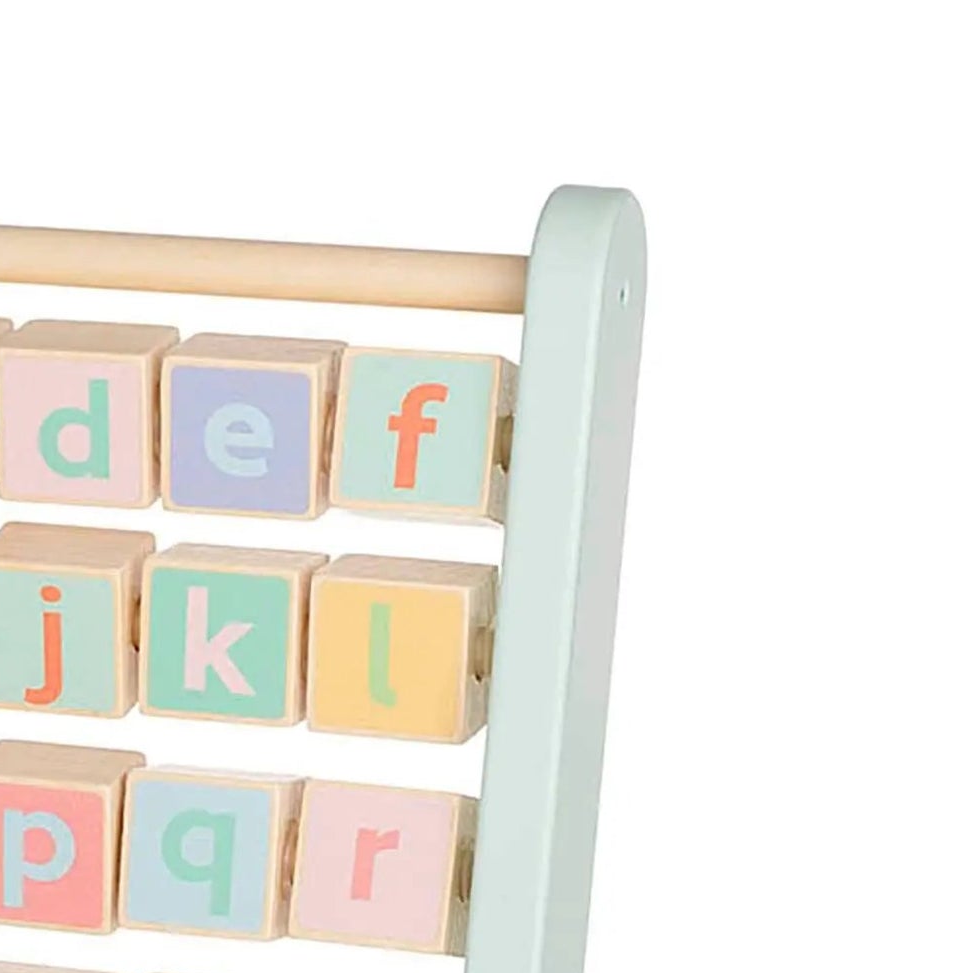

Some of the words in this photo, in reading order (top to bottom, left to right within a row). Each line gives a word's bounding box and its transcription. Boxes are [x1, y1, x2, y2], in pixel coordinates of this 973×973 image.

[38, 379, 110, 479] d
[204, 402, 275, 478] e
[387, 382, 449, 489] f
[24, 585, 63, 706] j
[183, 586, 255, 696] k
[369, 602, 397, 707] l
[2, 809, 76, 908] p
[160, 807, 236, 916] q
[350, 827, 399, 900] r
